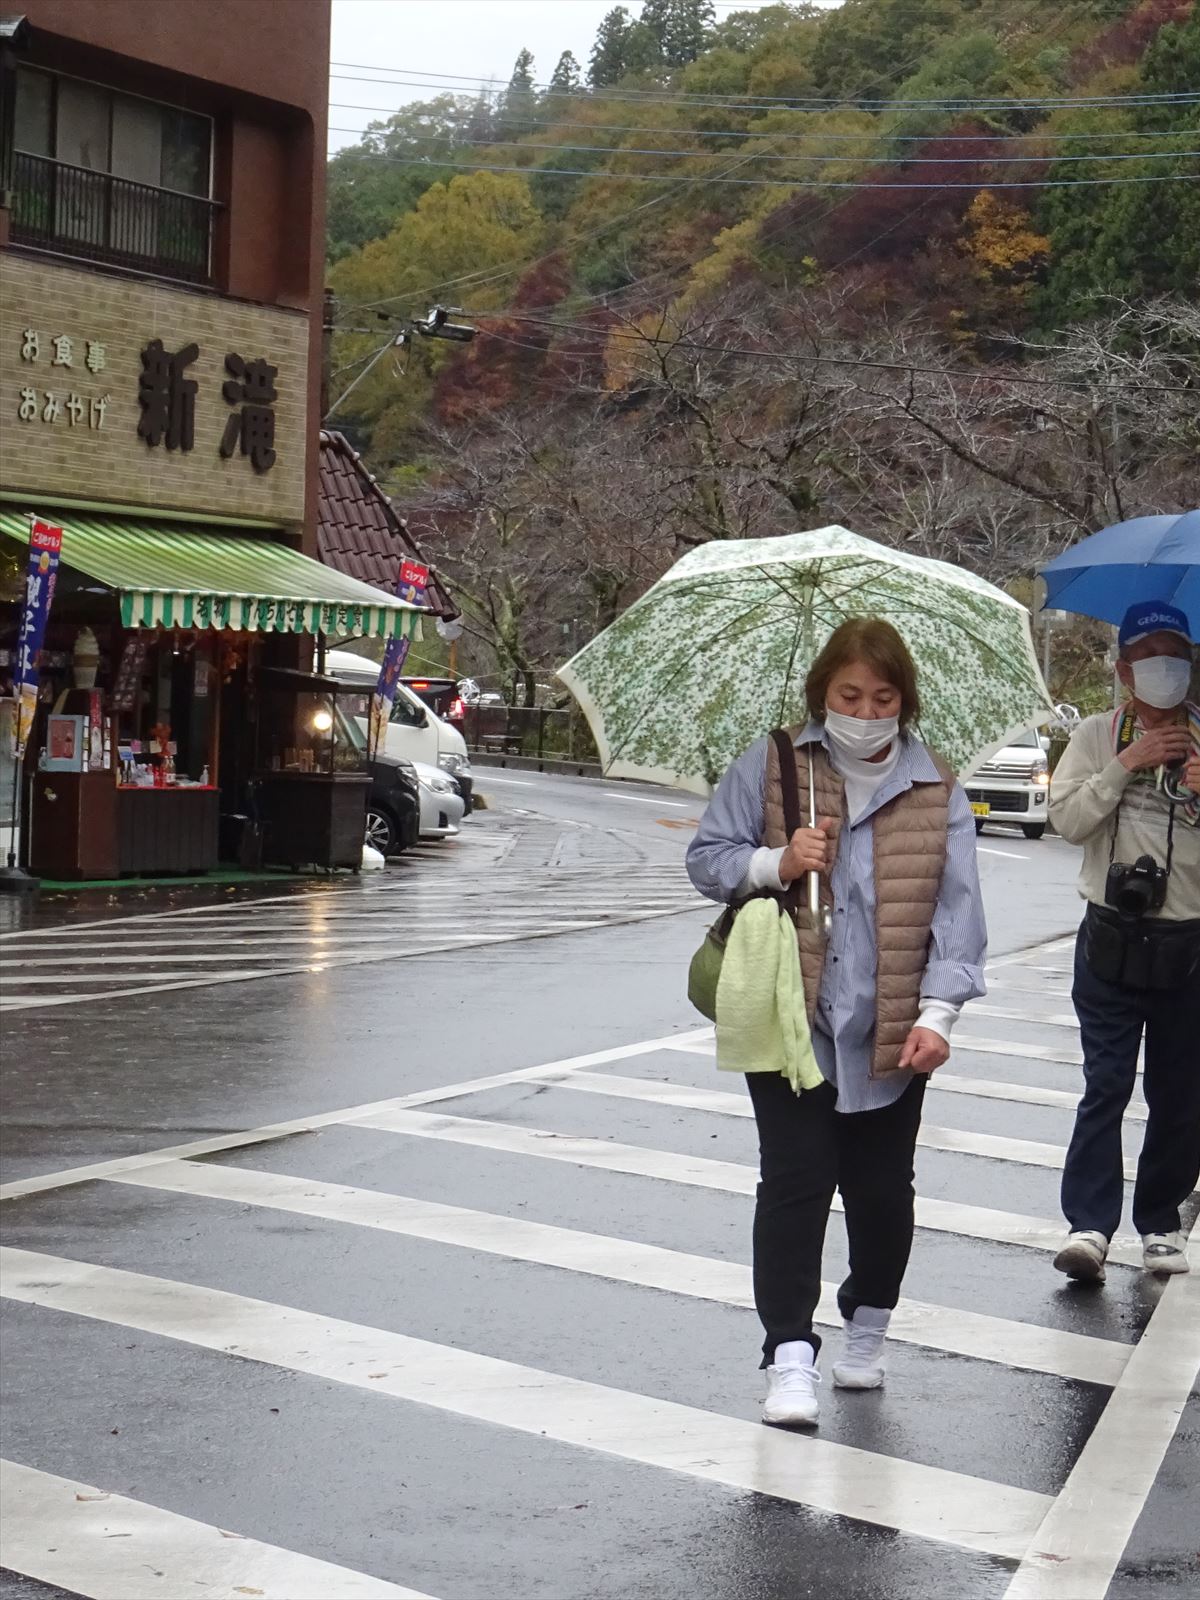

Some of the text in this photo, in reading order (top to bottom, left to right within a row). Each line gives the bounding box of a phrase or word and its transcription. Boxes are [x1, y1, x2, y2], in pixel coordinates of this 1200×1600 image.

[21, 329, 107, 373] お食事
[19, 387, 111, 430] おみやげ
[138, 339, 278, 474] 新滝
[1120, 715, 1133, 742] Nikon
